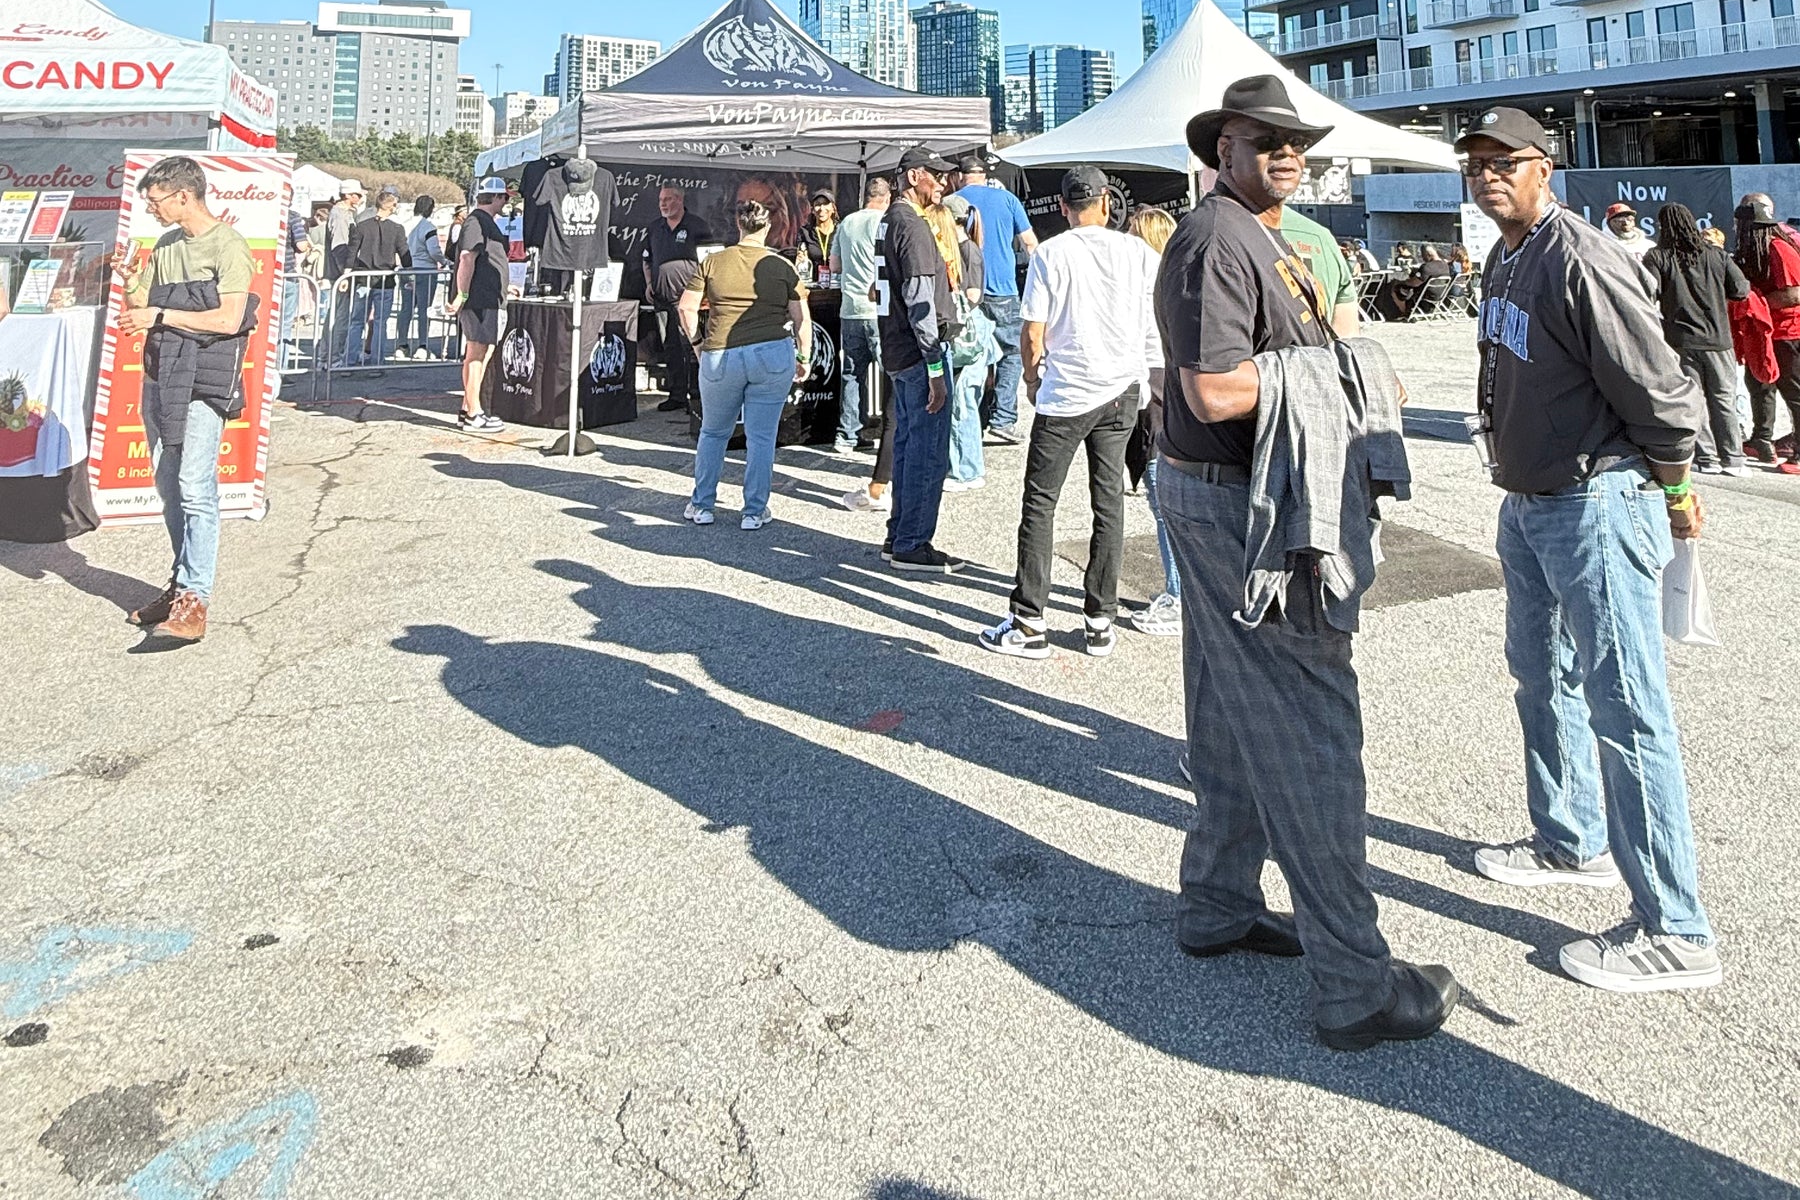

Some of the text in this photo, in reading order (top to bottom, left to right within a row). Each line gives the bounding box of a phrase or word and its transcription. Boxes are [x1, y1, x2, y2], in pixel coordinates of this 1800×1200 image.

[12, 23, 113, 42] Candy
[2, 60, 175, 90] CANDY
[721, 78, 853, 94] Von Payne
[705, 101, 887, 137] VonPayne.com
[615, 171, 641, 187] the
[1617, 180, 1667, 202] Now
[621, 192, 639, 216] of
[1030, 195, 1053, 208] TASTE
[793, 389, 834, 409] Payne
[117, 466, 127, 479] 8
